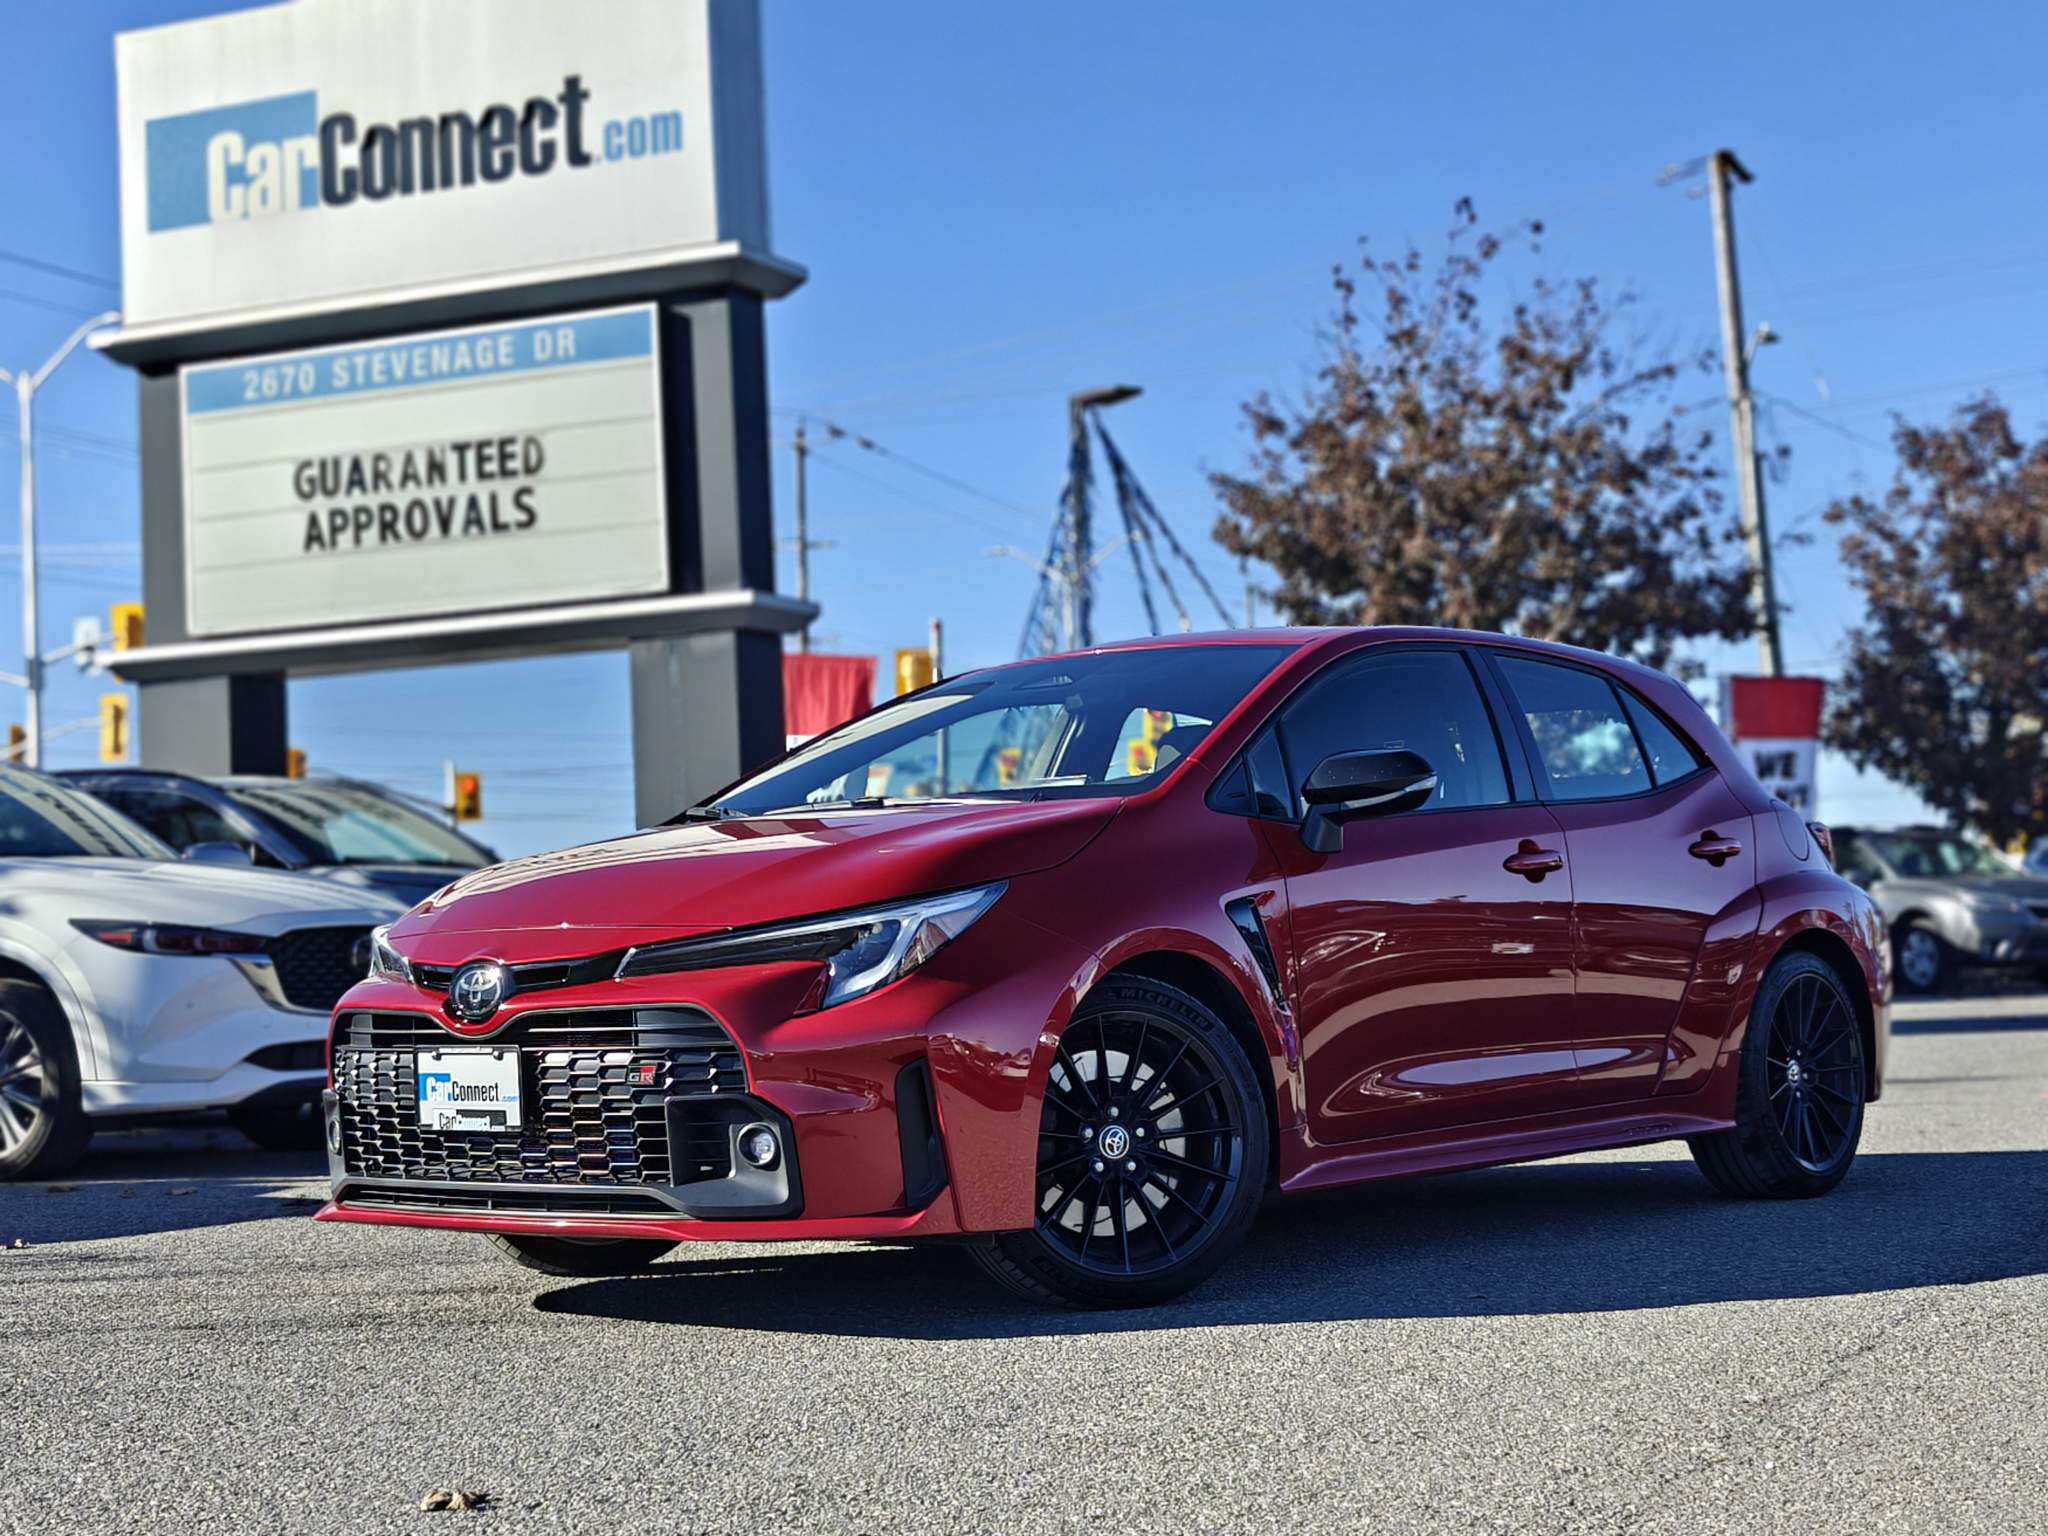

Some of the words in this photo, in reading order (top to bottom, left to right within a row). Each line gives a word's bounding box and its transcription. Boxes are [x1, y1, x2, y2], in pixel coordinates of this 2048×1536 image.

[206, 74, 683, 222] CarConnect.com
[243, 364, 316, 400] 2670
[332, 333, 515, 388] STEVENAGE
[532, 328, 577, 362] DR
[293, 435, 546, 502] GUARANTEED
[302, 486, 538, 554] APPROVALS
